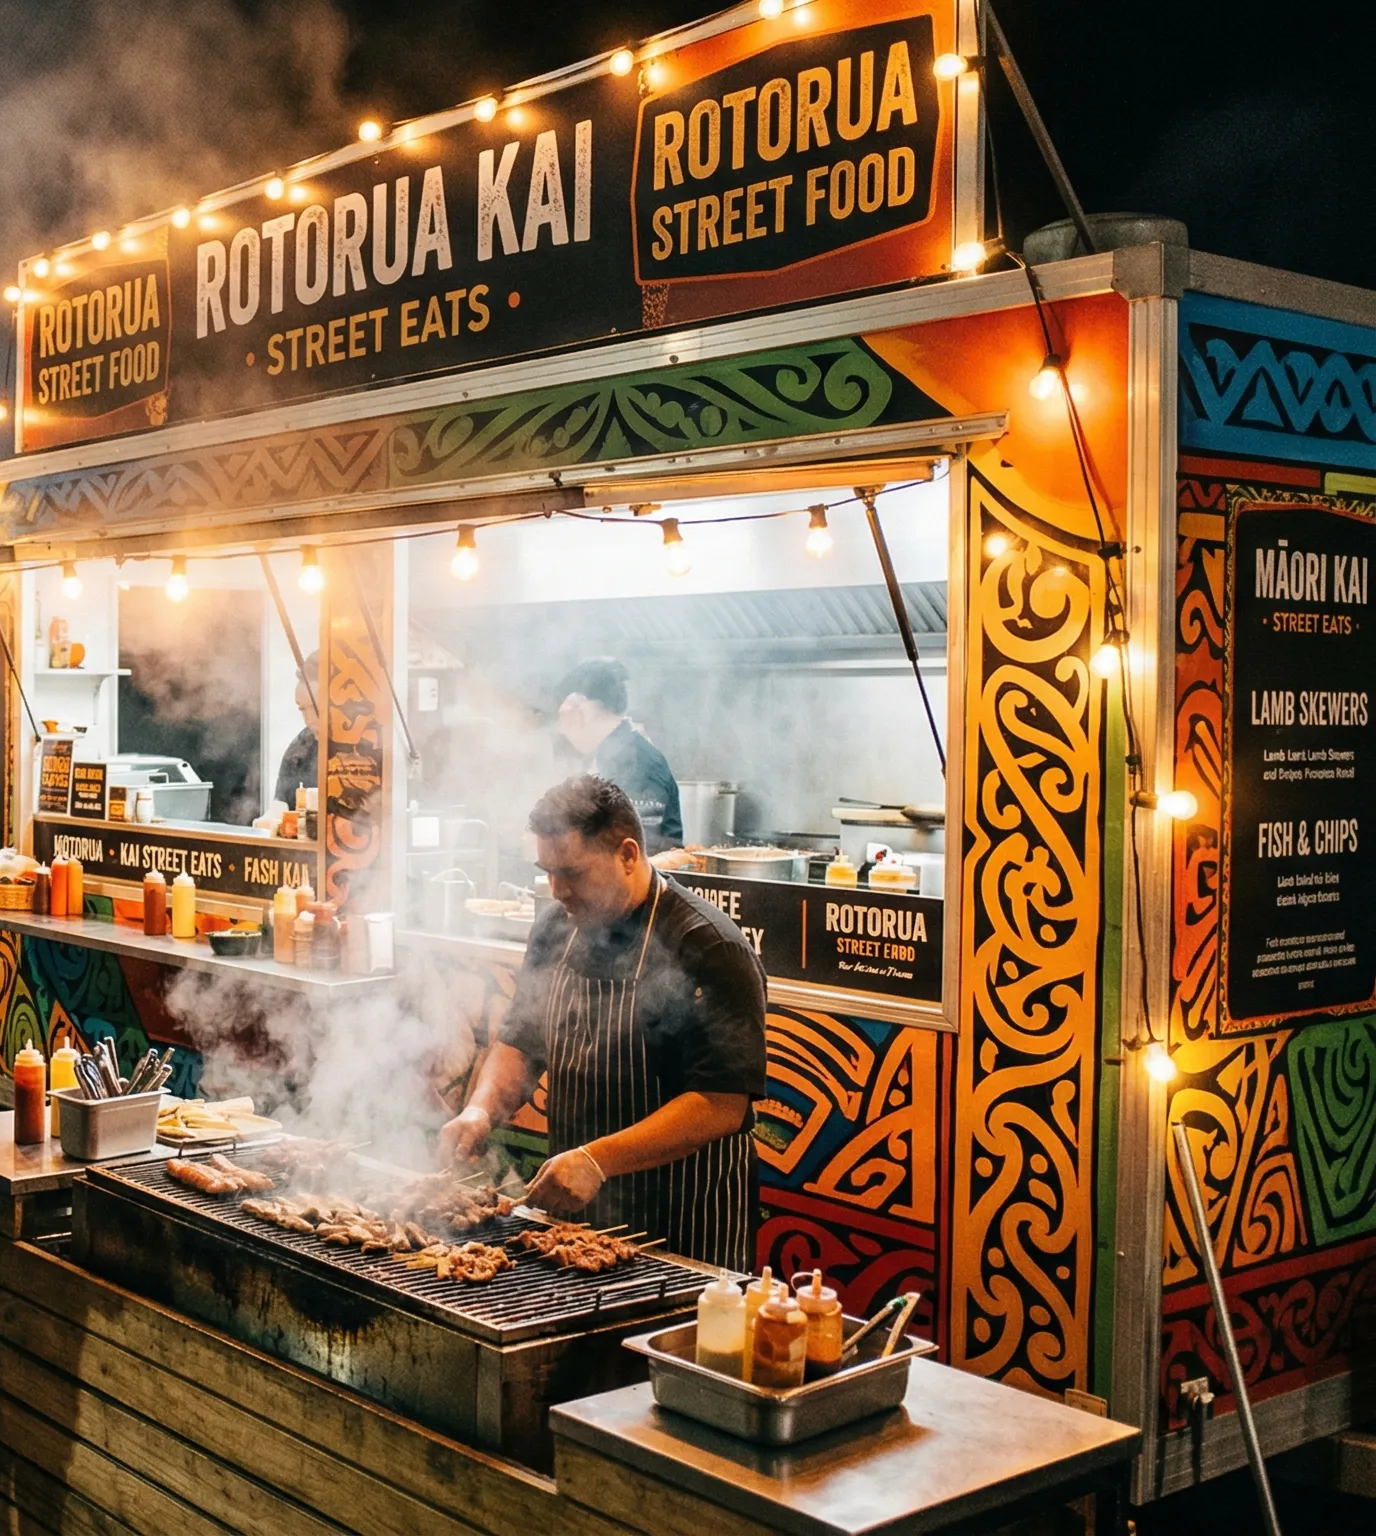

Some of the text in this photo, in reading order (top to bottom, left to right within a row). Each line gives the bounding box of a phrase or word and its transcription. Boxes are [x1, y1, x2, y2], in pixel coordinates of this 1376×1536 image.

[652, 40, 919, 191] ROTORUA
[195, 119, 592, 340] ROTORUA KAI
[651, 146, 917, 261] STREET FOOD
[39, 274, 161, 359] ROTORUA
[266, 283, 491, 377] STREET EATS
[37, 342, 160, 405] STREET FOOD
[1255, 539, 1368, 605] MĀORI KAI
[1273, 611, 1352, 635] STREET EATS
[1251, 690, 1369, 726] LAMB SKEWERS
[119, 842, 140, 868] KAI
[142, 845, 188, 874] STREET
[191, 850, 222, 878] EATS
[244, 856, 279, 886] FASH
[1258, 818, 1359, 858] FISH & CHIPS
[825, 902, 928, 943] ROTORUA
[836, 937, 881, 958] STREET
